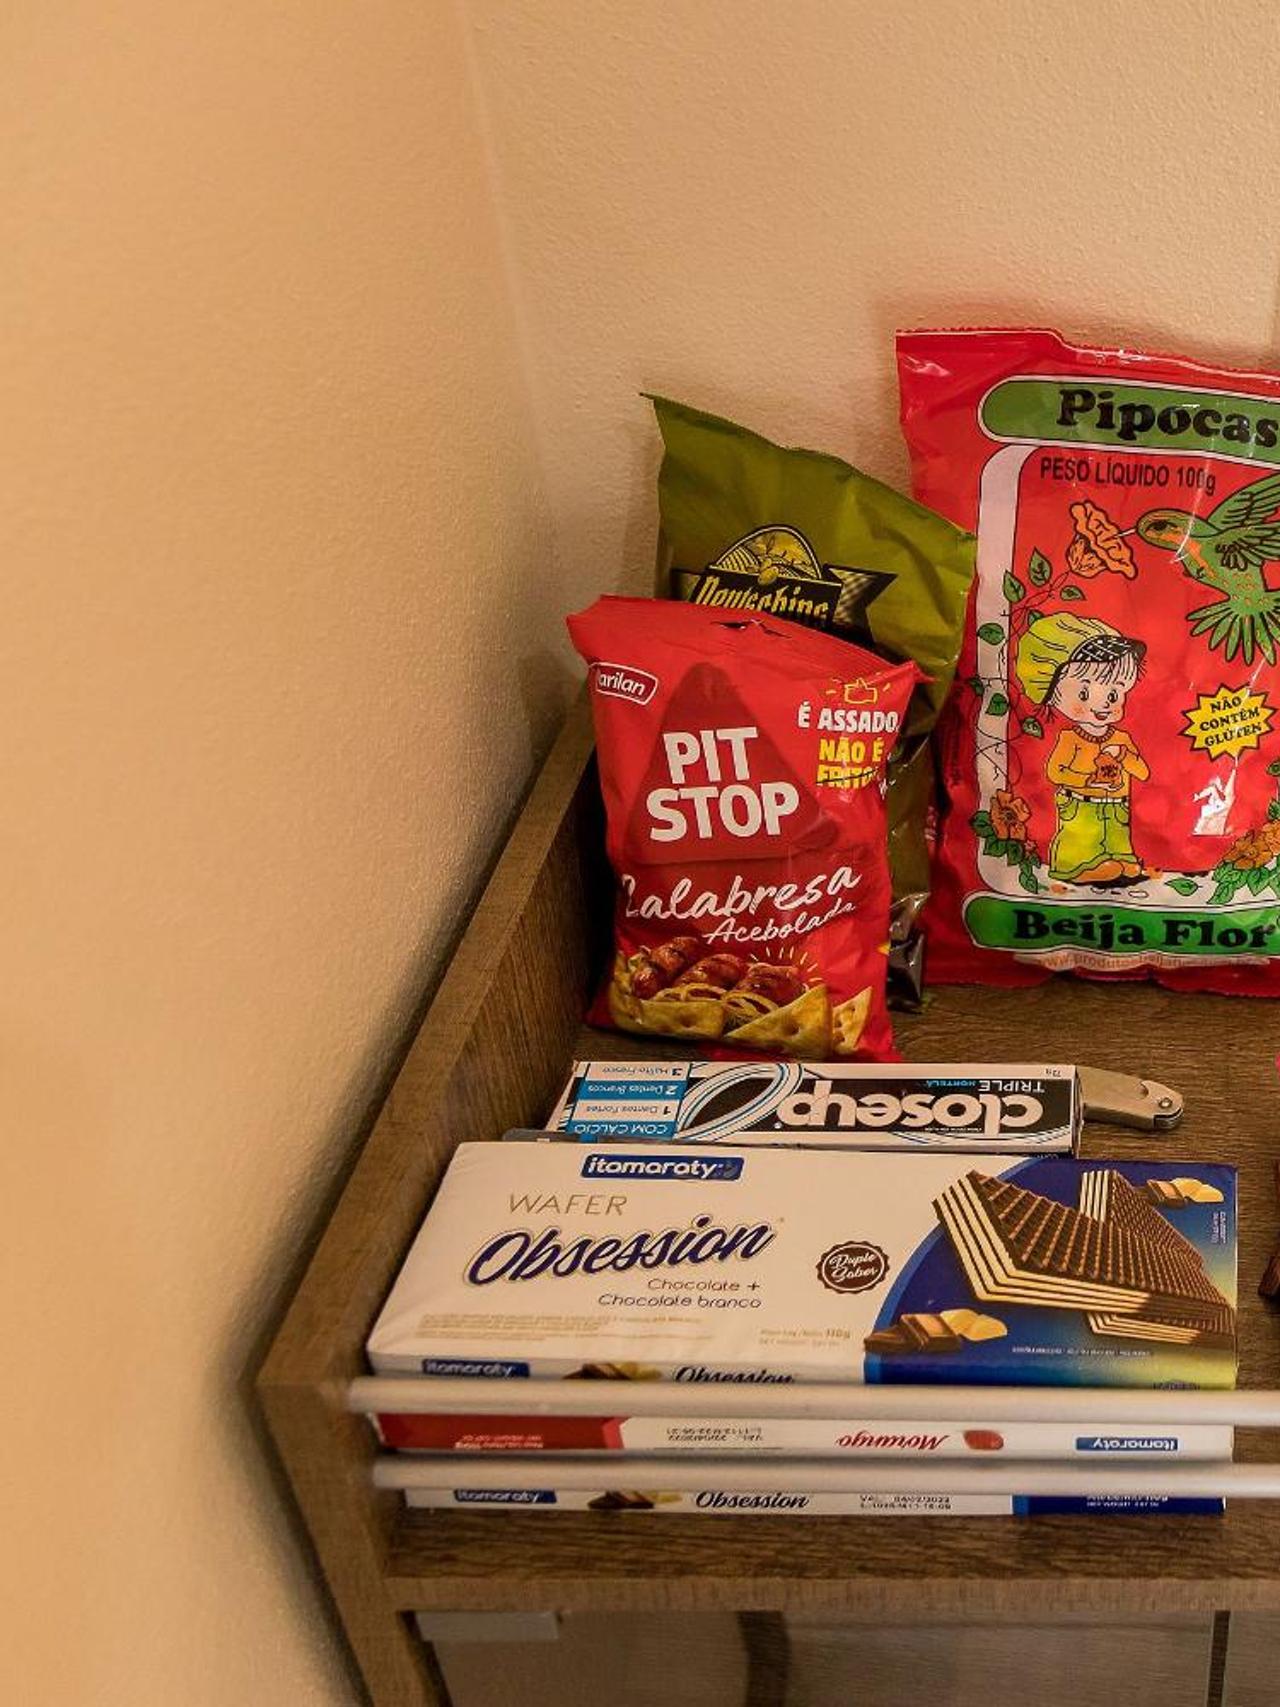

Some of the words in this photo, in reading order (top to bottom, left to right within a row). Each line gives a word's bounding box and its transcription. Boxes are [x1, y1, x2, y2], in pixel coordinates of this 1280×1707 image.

[1056, 388, 1279, 448] Pipocas
[1040, 456, 1090, 482] PESO
[1095, 458, 1170, 487] LÍQUIDO
[597, 671, 646, 696] arilan
[798, 701, 811, 728] É
[1210, 696, 1242, 714] NÃO
[664, 727, 757, 784] PIT
[819, 736, 865, 763] NÃO
[872, 737, 885, 762] É
[646, 782, 800, 843] STOP
[702, 897, 857, 945] Acebolada
[1012, 908, 1147, 950] Beija
[671, 1067, 683, 1077] 3
[588, 1085, 628, 1096] Brancos
[629, 1085, 664, 1095] Dentes
[665, 1085, 679, 1095] 2
[978, 1079, 1045, 1094] TRIPLE
[662, 1105, 672, 1115] 1
[776, 1080, 1043, 1136] closeup
[631, 1124, 669, 1135] COM
[585, 1156, 717, 1179] itamaraty
[508, 1193, 629, 1217] WAFER
[464, 1213, 778, 1289] Obsession
[647, 1278, 740, 1292] Chocolate
[598, 1293, 692, 1308] Chocolate
[699, 1293, 762, 1308] branco
[426, 1360, 515, 1379] itamaraty
[672, 1364, 798, 1384] Obsession
[837, 1430, 949, 1450] Morango
[1093, 1437, 1177, 1450] itamaraty
[457, 1490, 539, 1504] itamaraty
[696, 1489, 809, 1509] Obsession
